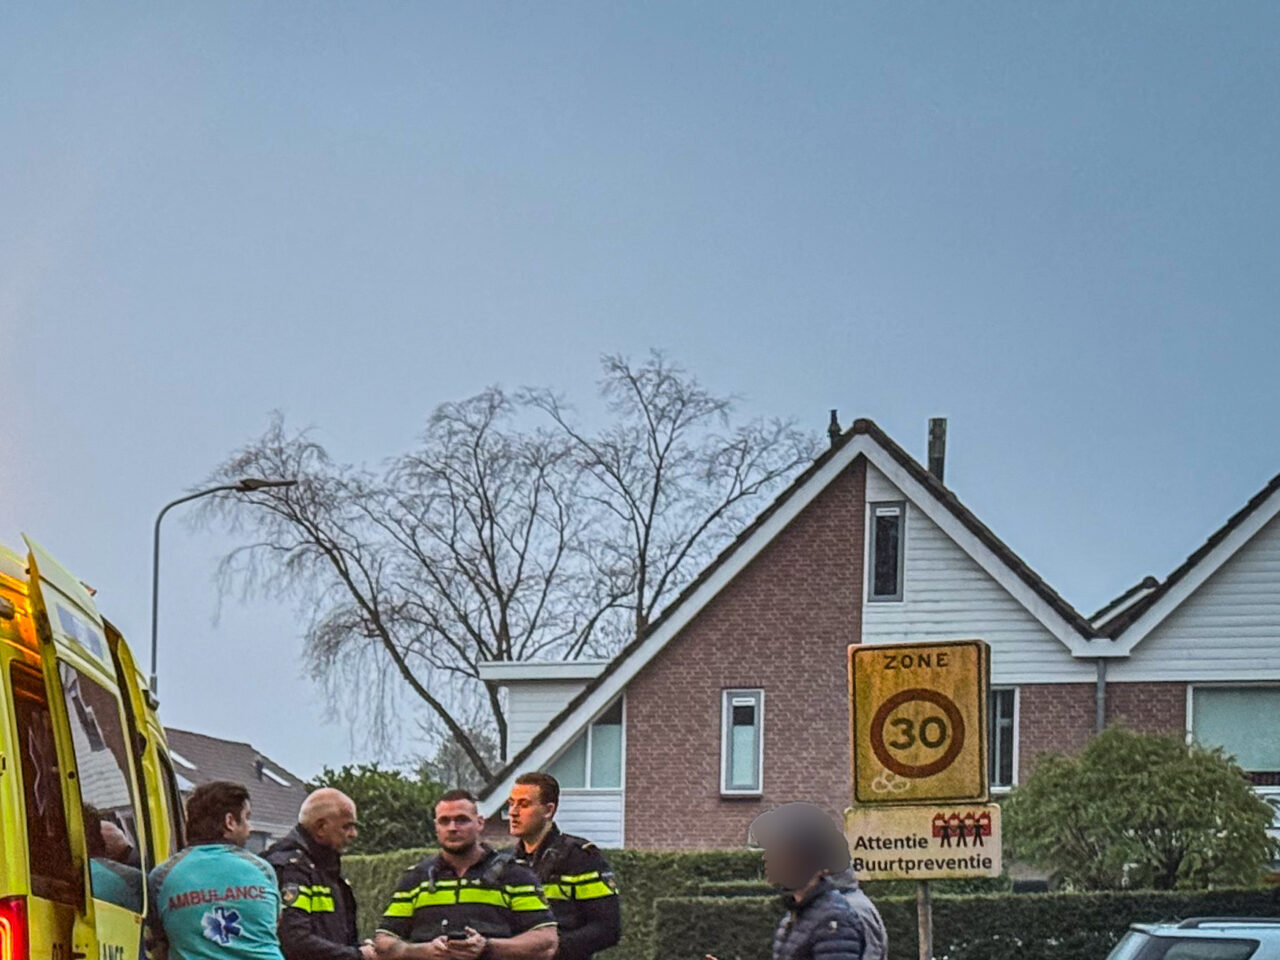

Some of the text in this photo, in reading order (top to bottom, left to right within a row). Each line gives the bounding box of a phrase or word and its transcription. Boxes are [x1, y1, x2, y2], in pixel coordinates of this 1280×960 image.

[883, 652, 949, 670] ZONE
[887, 716, 947, 750] 30
[854, 833, 929, 850] Attentie
[852, 853, 992, 874] Buurtpreventie
[168, 886, 267, 911] AMBULANCE
